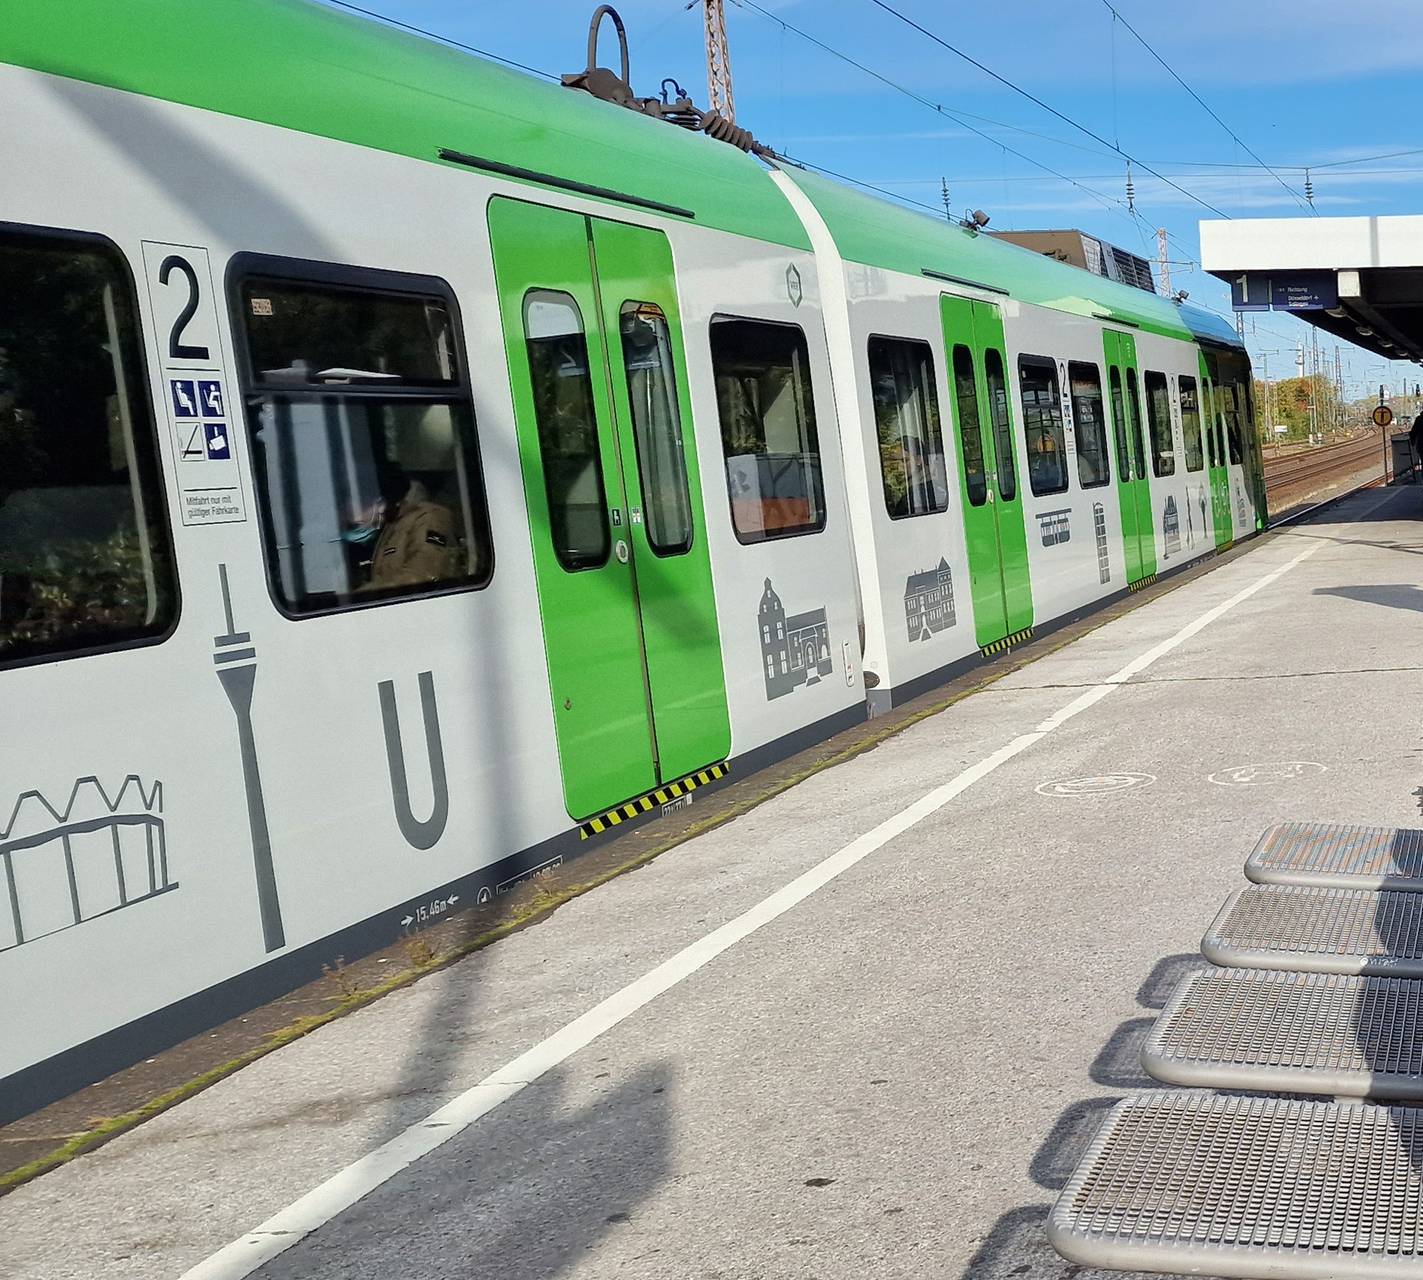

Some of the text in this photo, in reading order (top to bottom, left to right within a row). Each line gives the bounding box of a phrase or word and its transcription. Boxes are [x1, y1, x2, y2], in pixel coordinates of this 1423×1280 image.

[1236, 275, 1248, 303] 1
[159, 255, 210, 360] 2
[186, 496, 209, 505] Mitfahrt
[222, 495, 231, 504] mit
[188, 506, 239, 519] gültiger Fahrkarte
[378, 671, 449, 850] U
